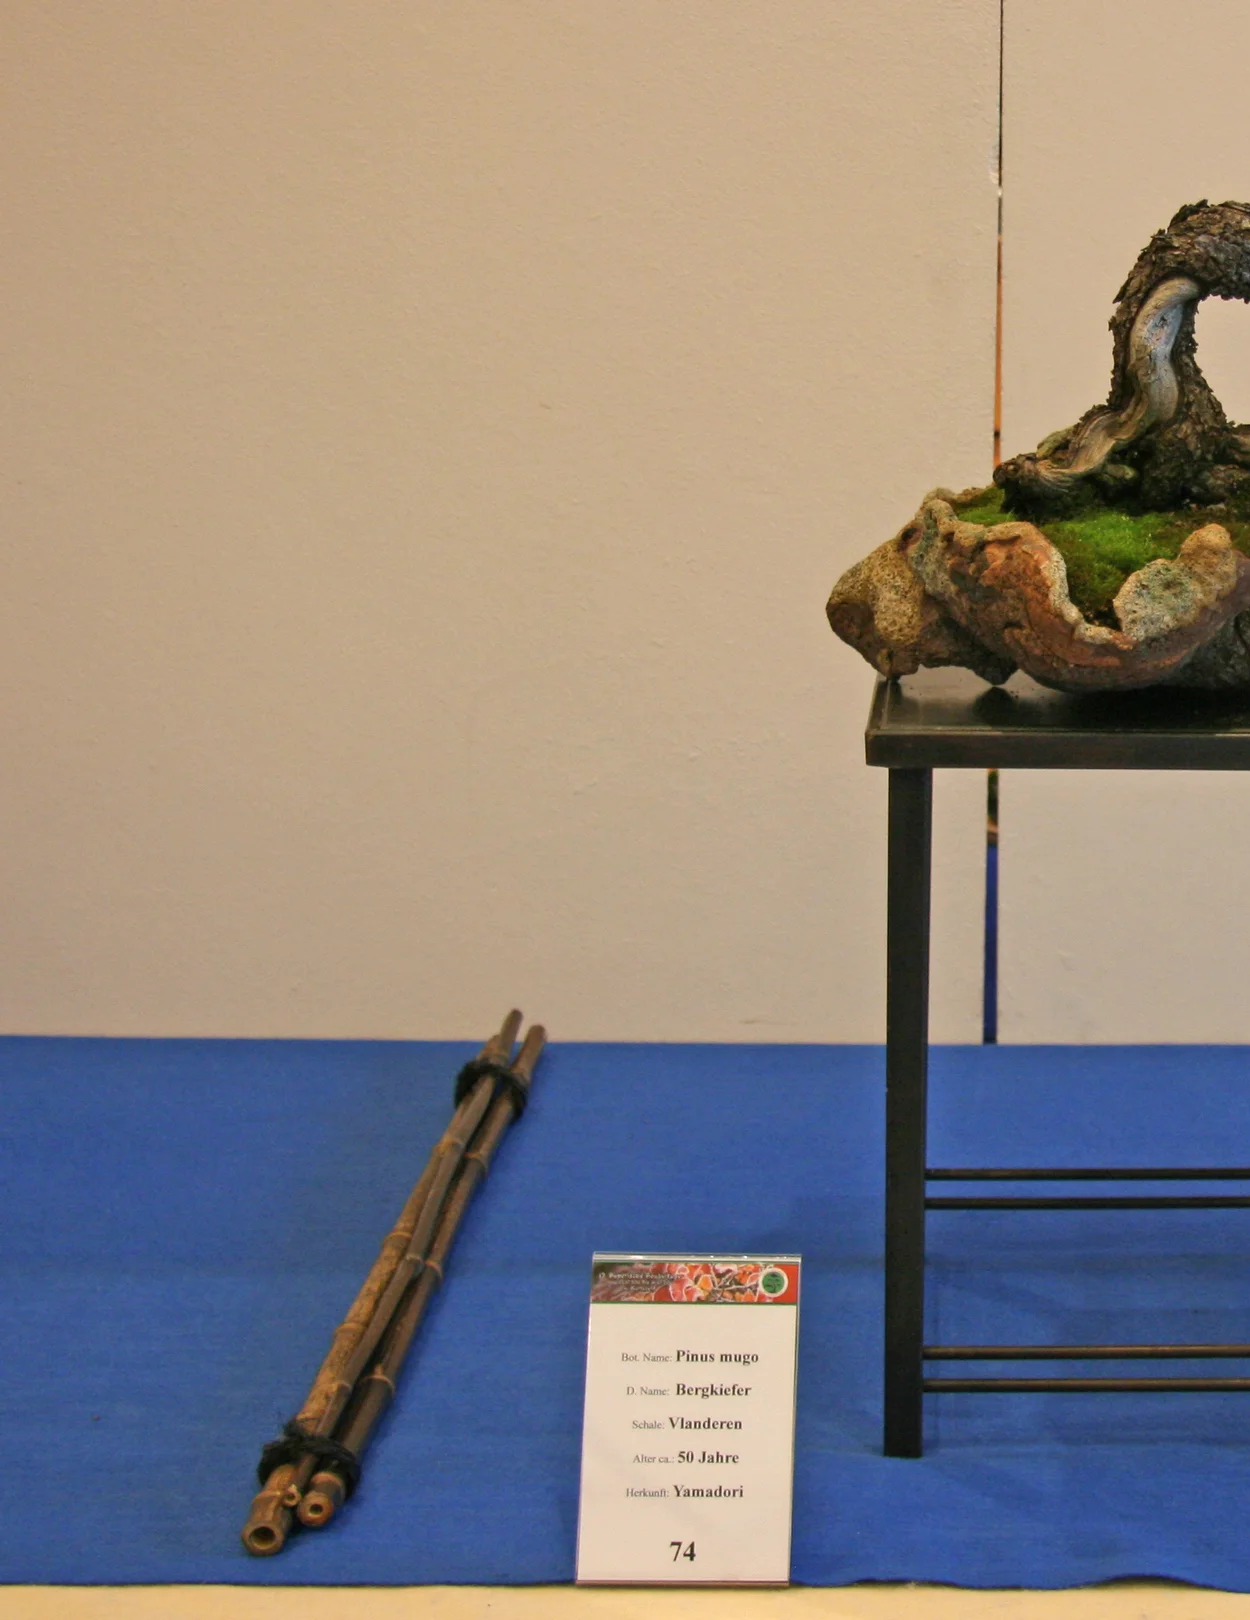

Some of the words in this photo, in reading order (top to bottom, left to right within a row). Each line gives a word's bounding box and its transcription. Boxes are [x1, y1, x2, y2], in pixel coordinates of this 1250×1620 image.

[621, 1352, 640, 1362] Bot.
[643, 1352, 672, 1362] Name:
[676, 1350, 715, 1363] Pinus
[720, 1354, 759, 1366] mugo
[626, 1386, 637, 1396] D.
[640, 1386, 669, 1396] Name:
[676, 1383, 751, 1399] Bergkiefer
[632, 1420, 665, 1429] Schale:
[669, 1417, 742, 1430] Vlanderen
[633, 1454, 655, 1463] Alter
[677, 1451, 694, 1463] 50
[698, 1451, 739, 1464] Jahre
[626, 1488, 669, 1498] Herkunft:
[673, 1485, 744, 1498] Yamadori
[669, 1541, 696, 1562] 74
